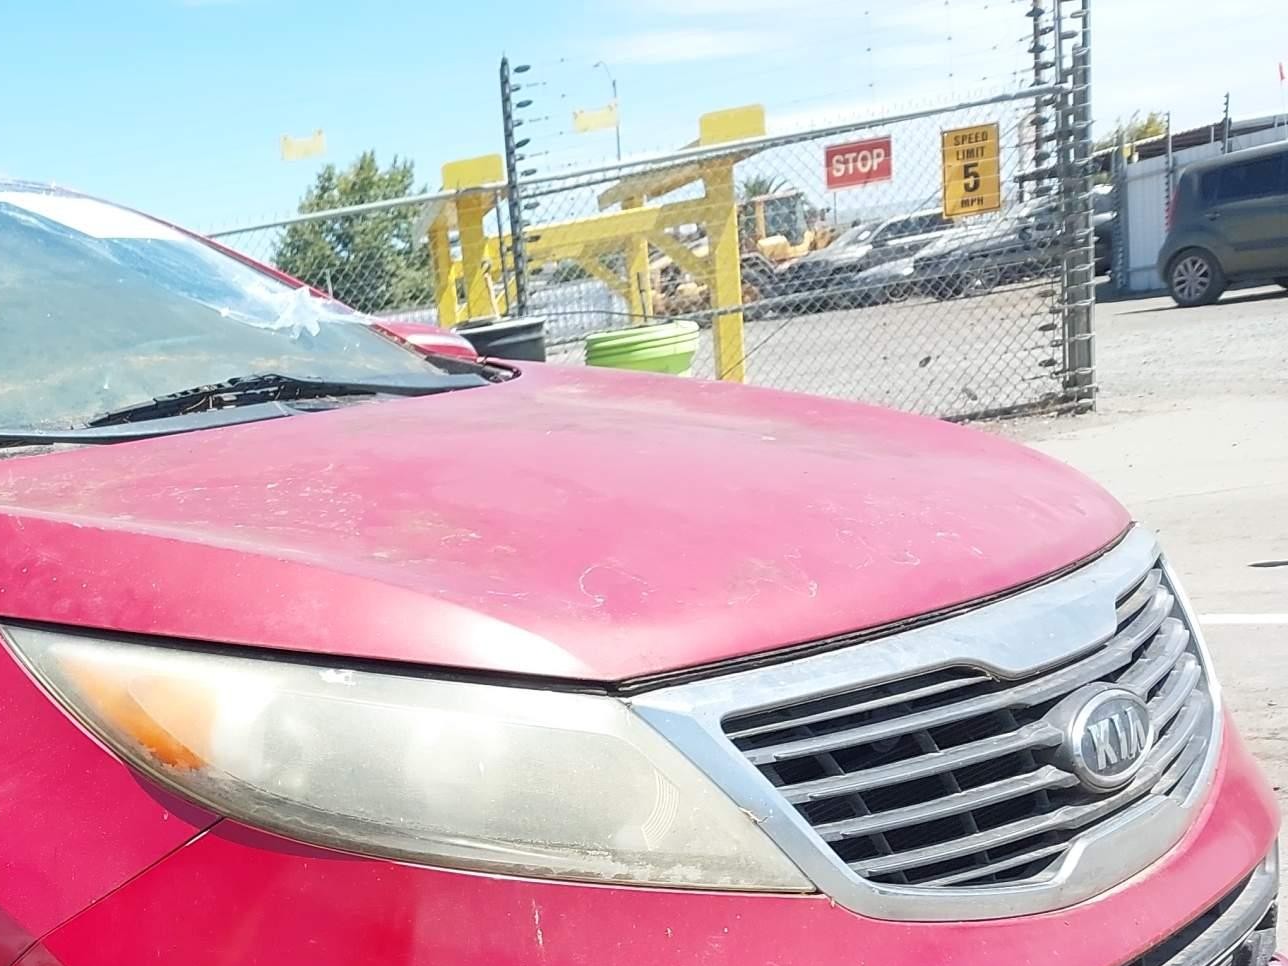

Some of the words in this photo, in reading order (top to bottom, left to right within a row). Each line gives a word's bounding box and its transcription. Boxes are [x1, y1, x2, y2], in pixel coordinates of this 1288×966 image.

[953, 131, 988, 146] SPEED
[832, 148, 885, 177] STOP
[956, 146, 985, 161] LIMIT
[963, 162, 981, 193] 5
[960, 197, 984, 207] MPH
[1087, 706, 1145, 770] KIA
